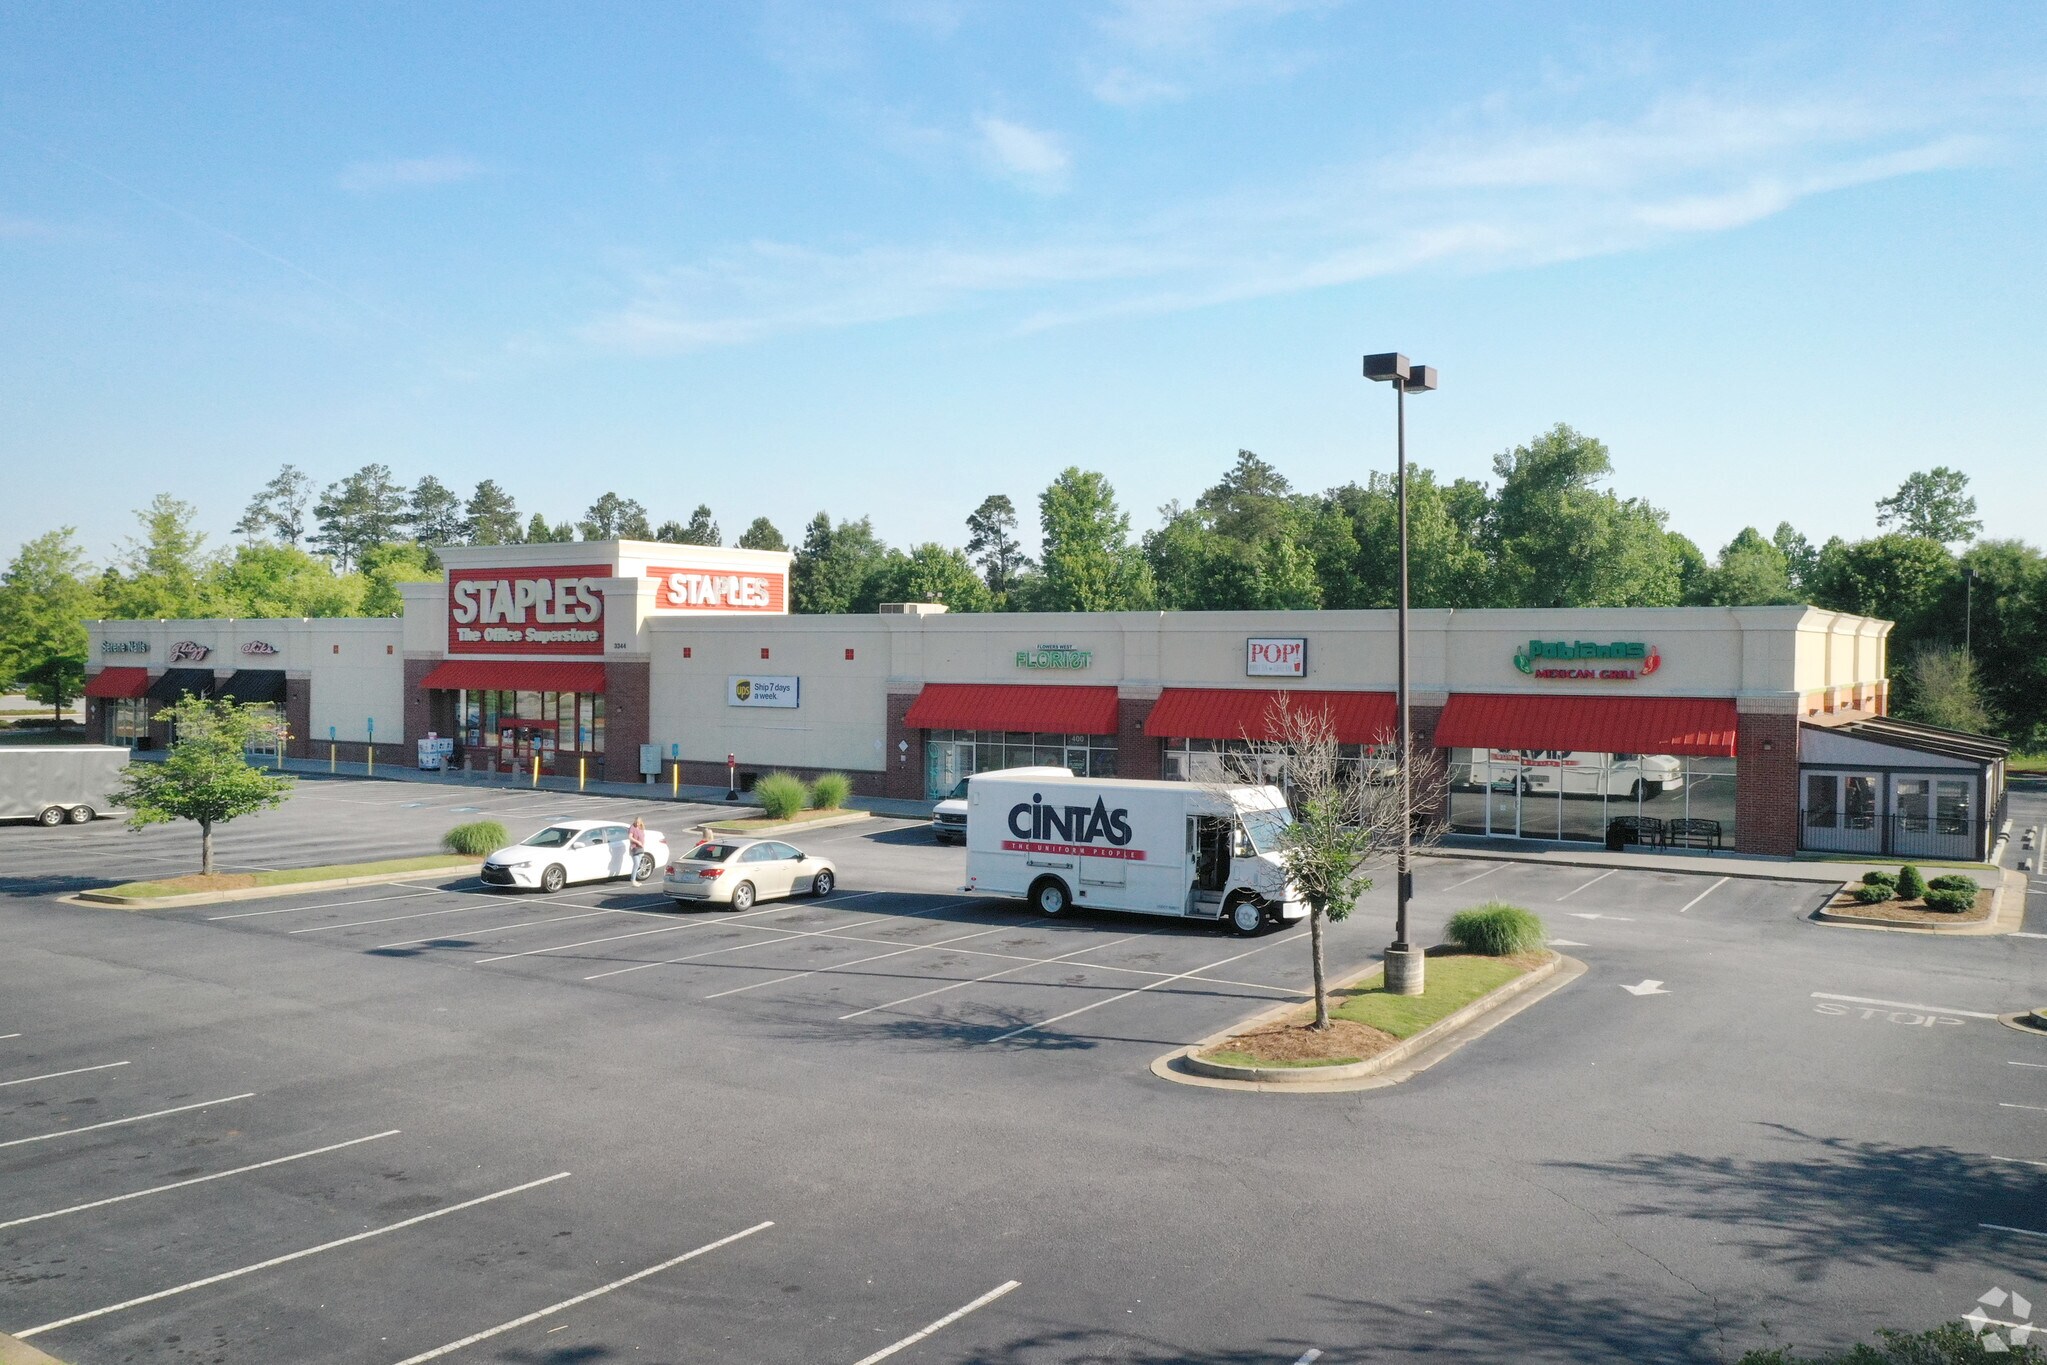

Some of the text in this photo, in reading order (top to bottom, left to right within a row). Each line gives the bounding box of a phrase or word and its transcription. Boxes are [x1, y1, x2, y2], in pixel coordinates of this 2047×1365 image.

[667, 572, 770, 606] STAPLES
[453, 577, 604, 624] STAPLES
[457, 627, 599, 644] The Office Superstore
[102, 641, 147, 653] Serene Nails
[1015, 650, 1092, 669] FLORIST
[1535, 669, 1637, 680] MEXICAN GRILL
[754, 683, 790, 693] Ship 7 days
[1012, 842, 1136, 858] THE UNIFORM PEOPLE
[1812, 1003, 1966, 1027] STOP
